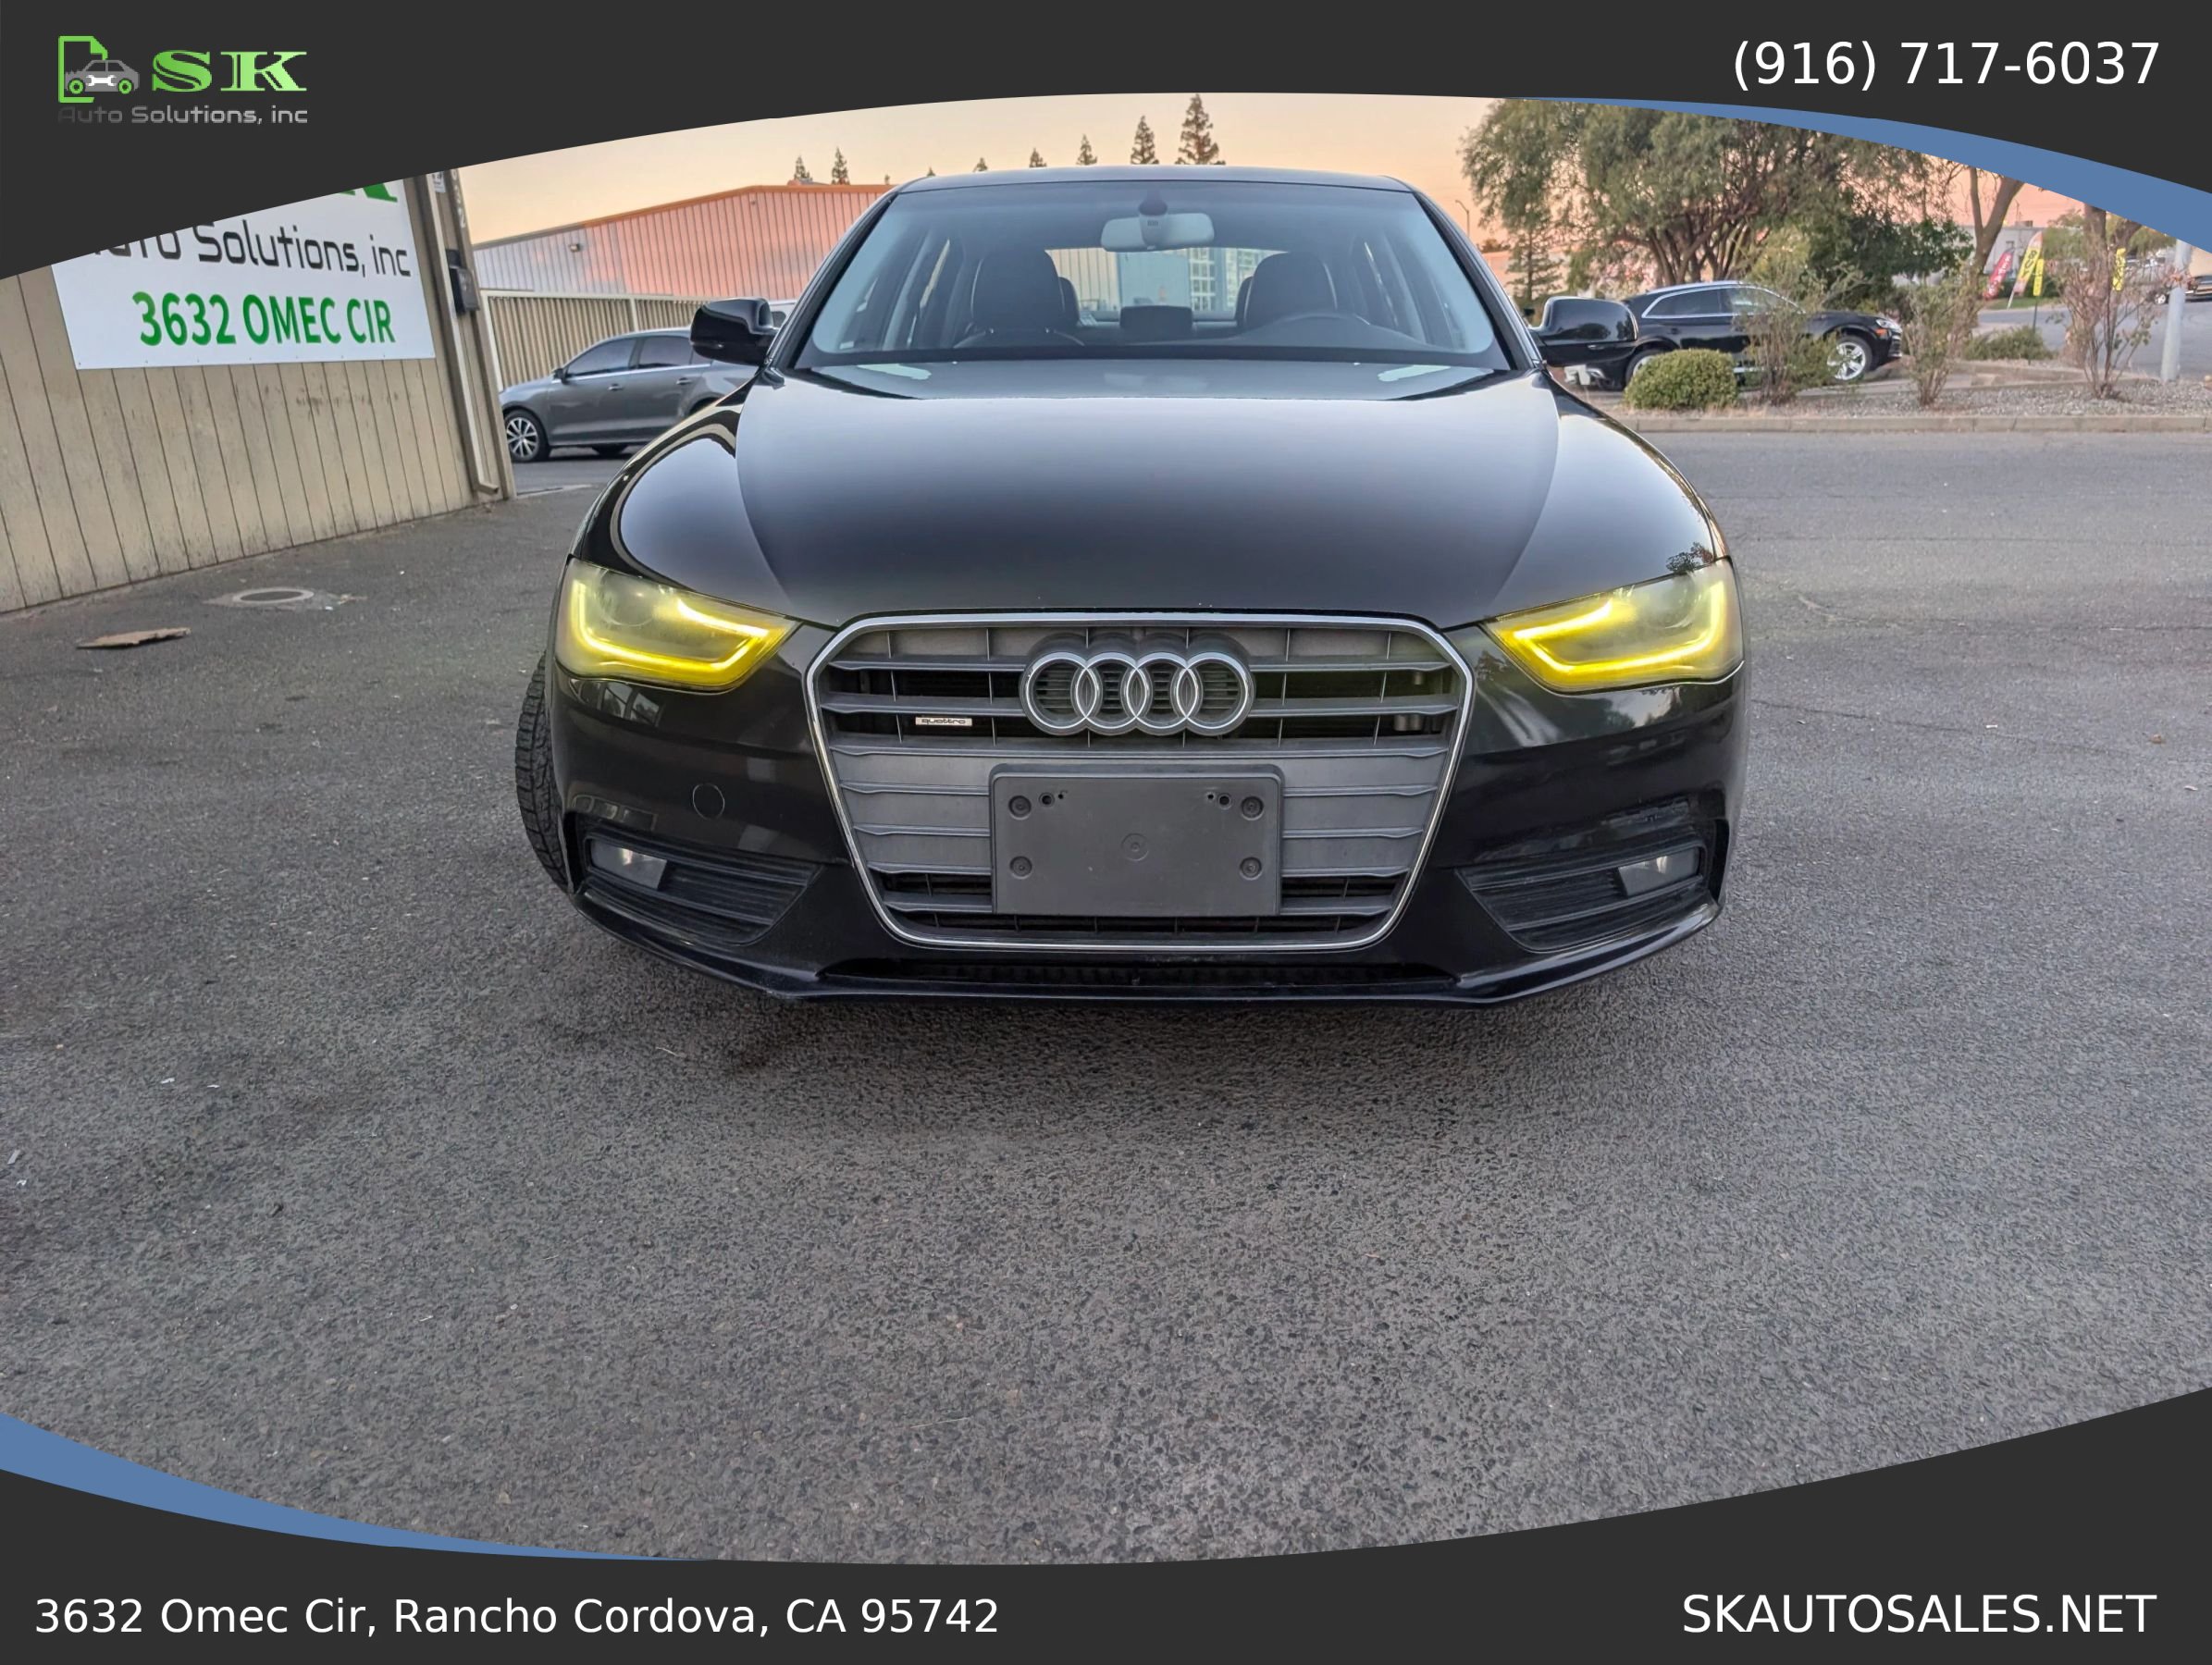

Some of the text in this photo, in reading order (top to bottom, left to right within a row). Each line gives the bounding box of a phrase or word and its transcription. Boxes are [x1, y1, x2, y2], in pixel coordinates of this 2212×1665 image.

[192, 218, 367, 277] Solutions,
[369, 233, 411, 277] inc
[132, 291, 395, 347] 3632 OMEC CIR
